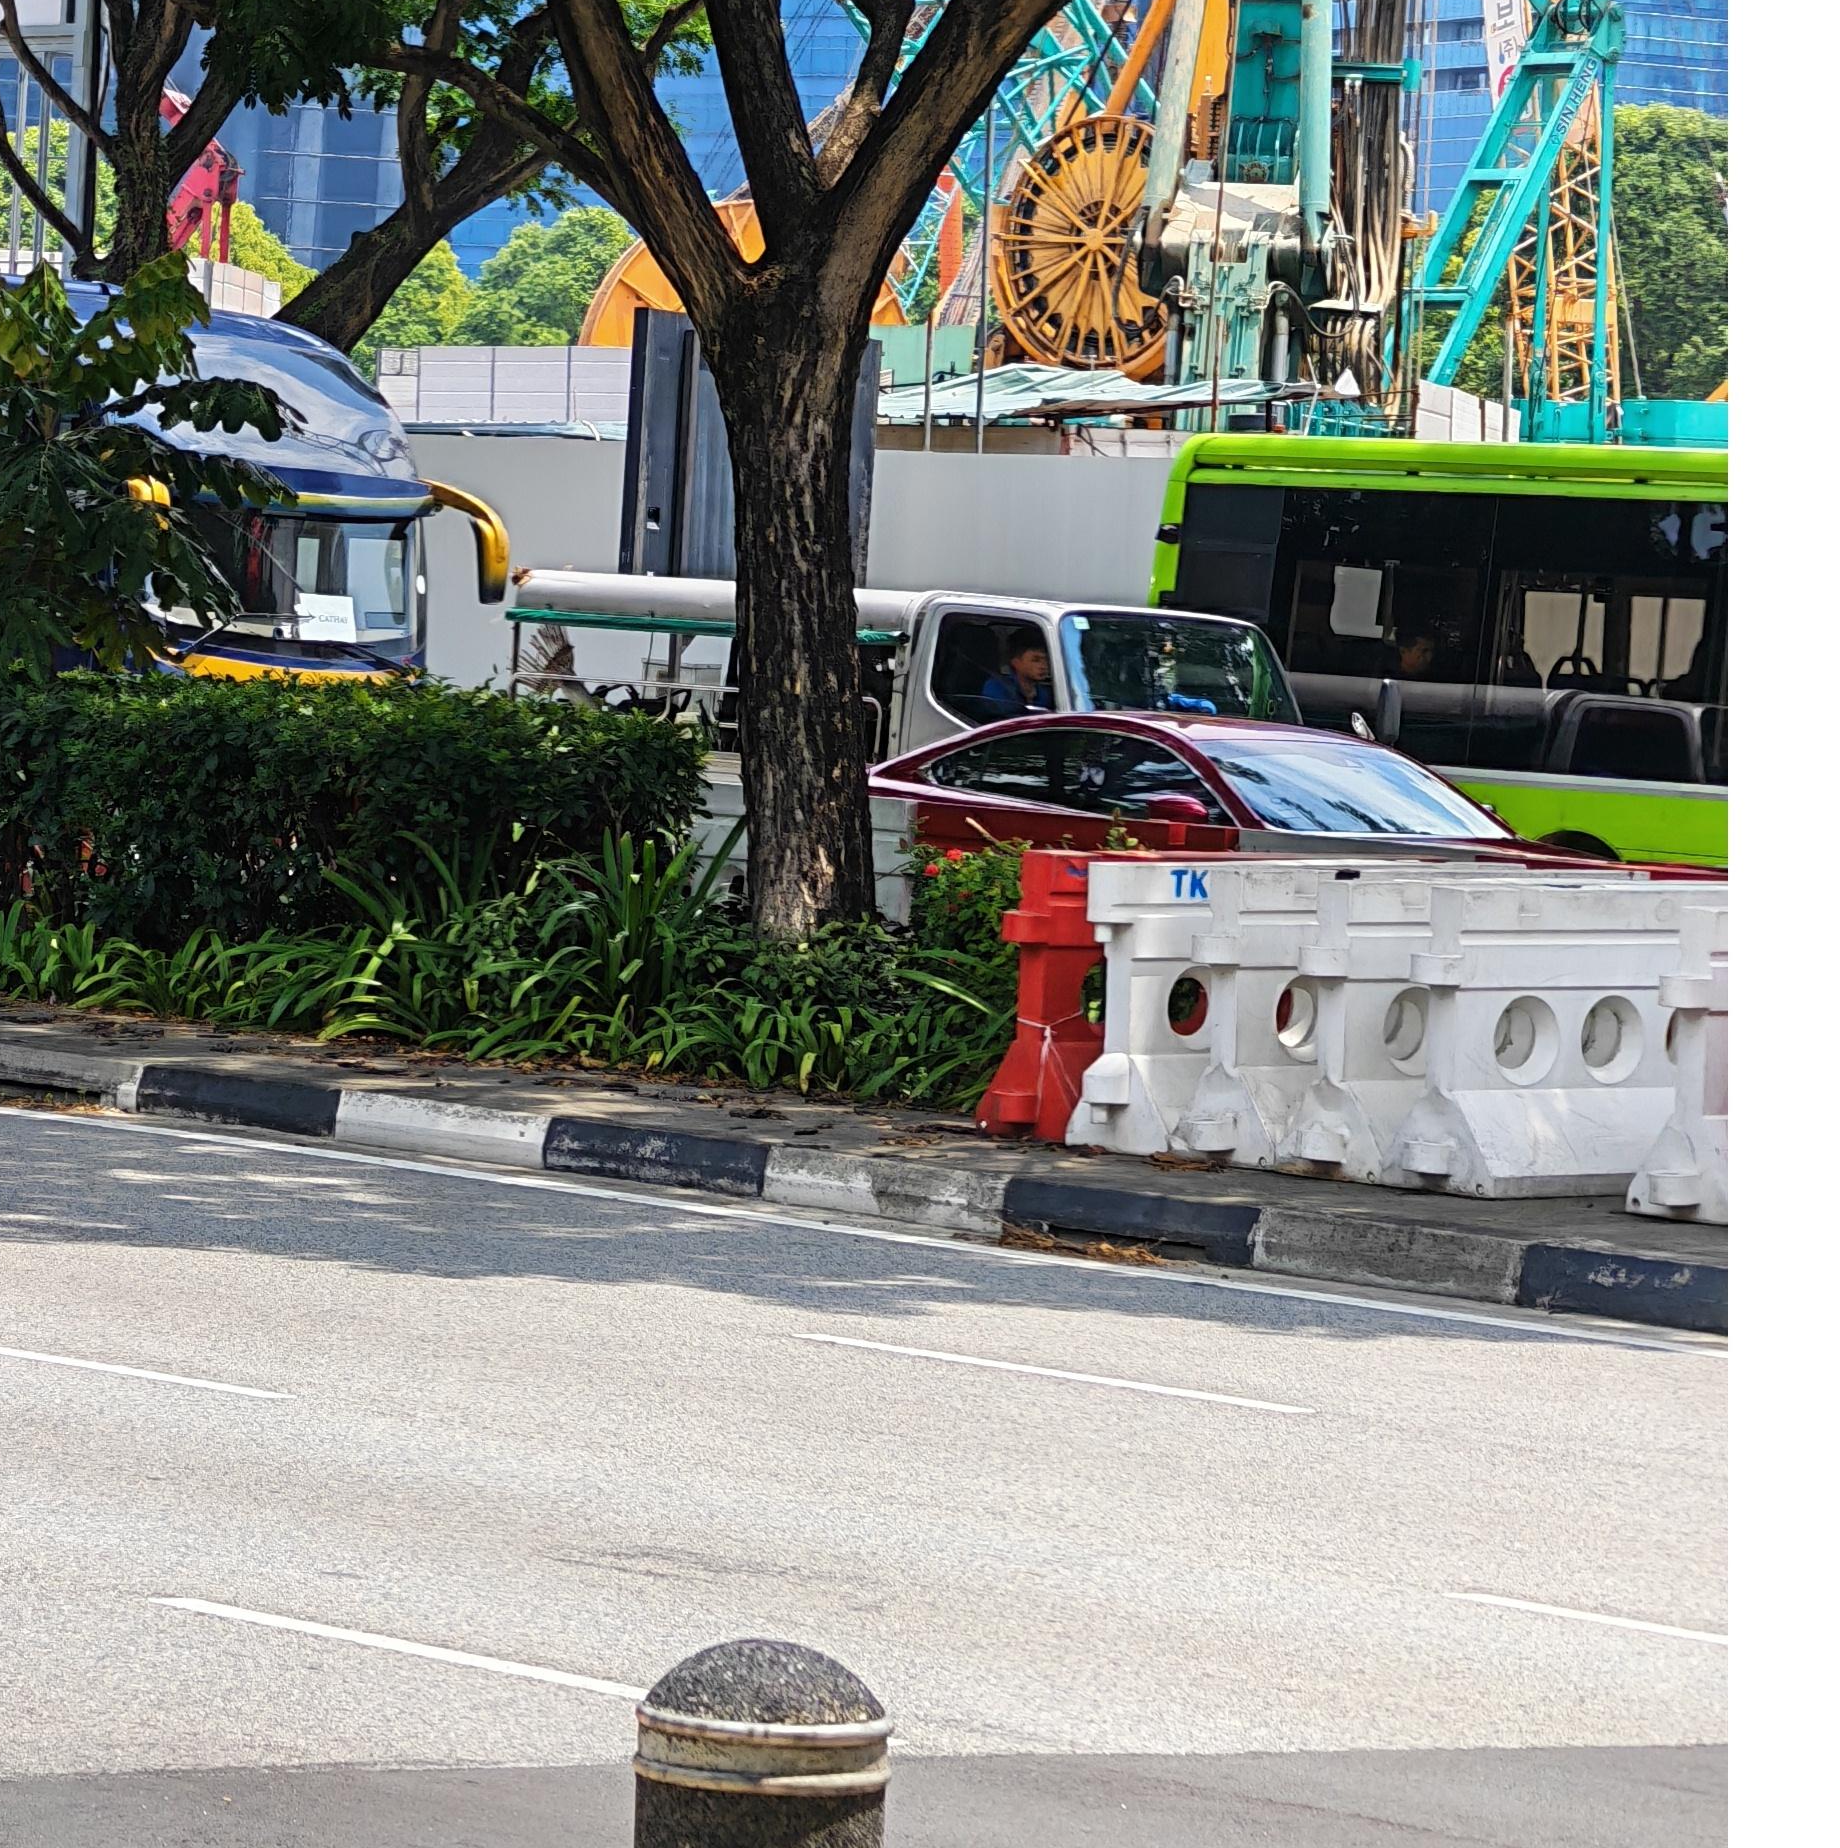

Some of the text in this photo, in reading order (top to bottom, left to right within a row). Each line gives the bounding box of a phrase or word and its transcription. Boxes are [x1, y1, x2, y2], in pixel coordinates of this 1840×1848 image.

[1556, 56, 1598, 135] SIN HENG
[1170, 869, 1209, 899] TK
